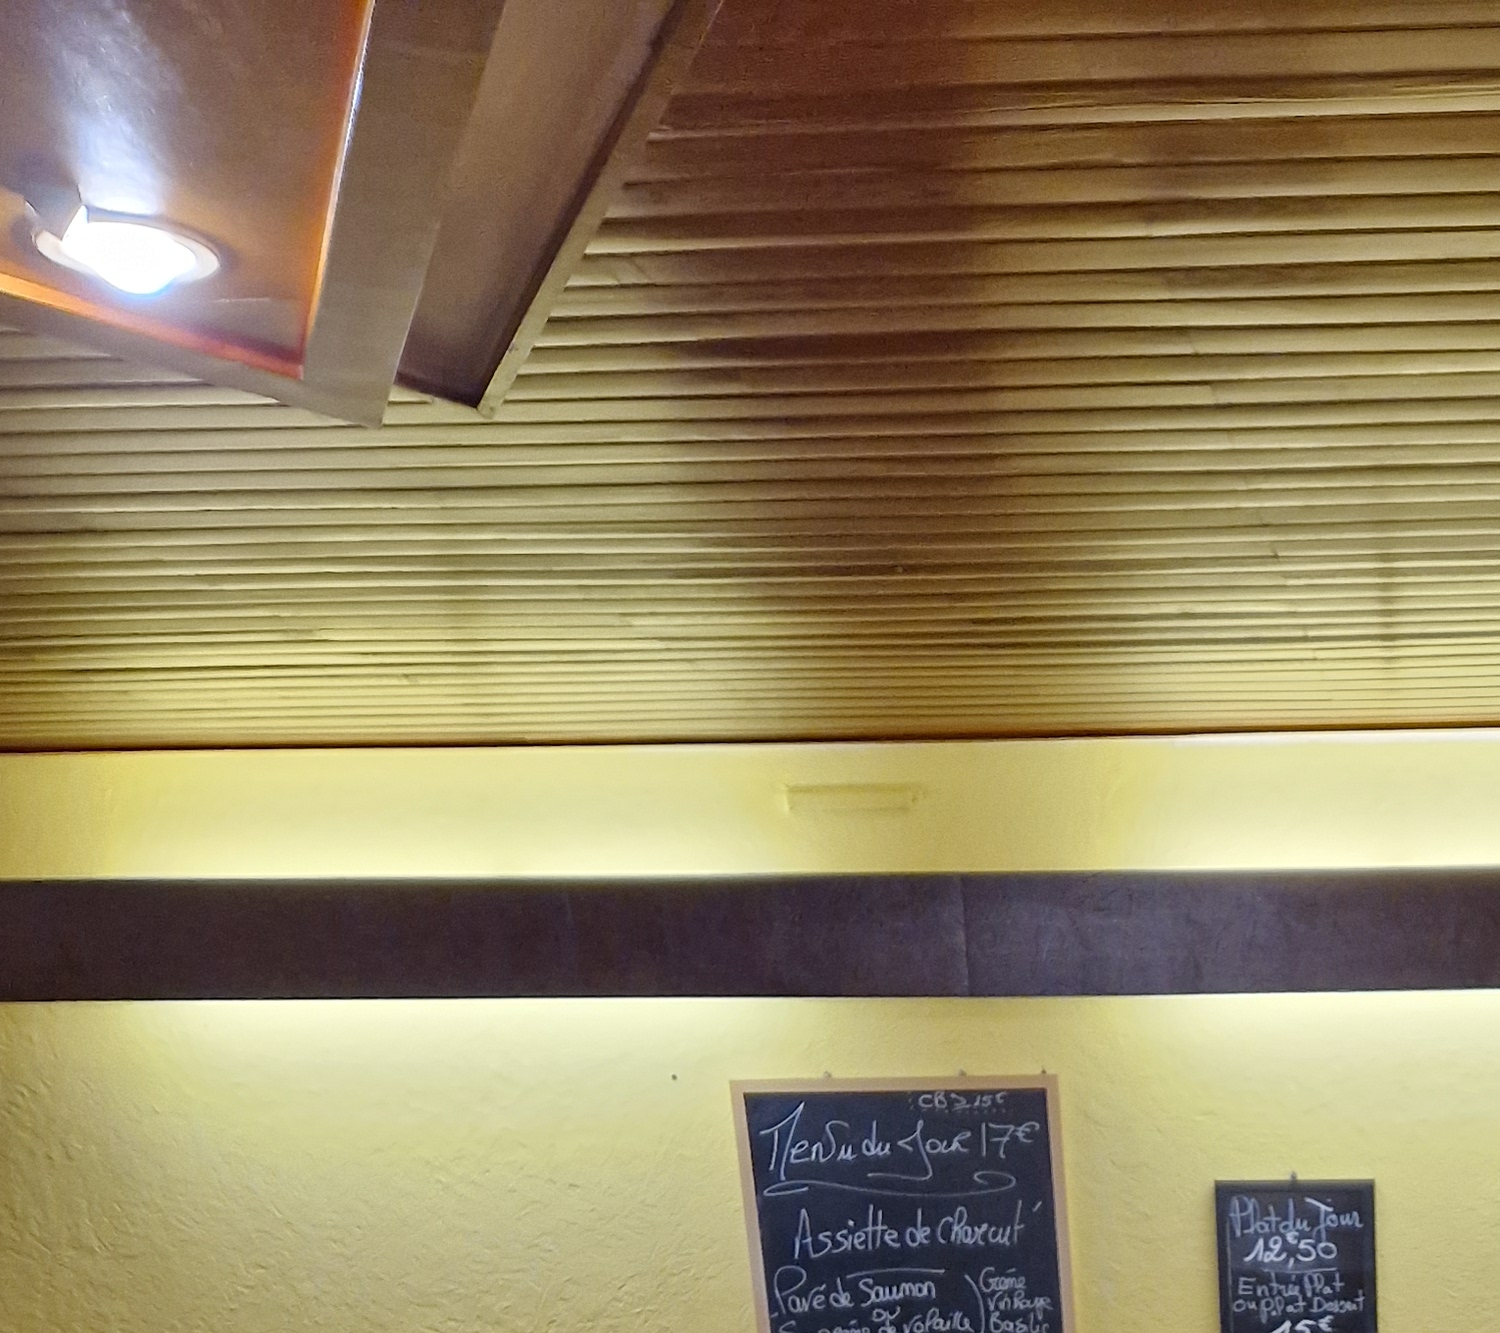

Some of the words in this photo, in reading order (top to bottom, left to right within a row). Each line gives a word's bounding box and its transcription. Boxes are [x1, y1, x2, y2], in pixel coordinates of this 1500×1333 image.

[861, 1119, 892, 1156] du
[793, 1204, 900, 1259] Assiette
[905, 1208, 931, 1248] de
